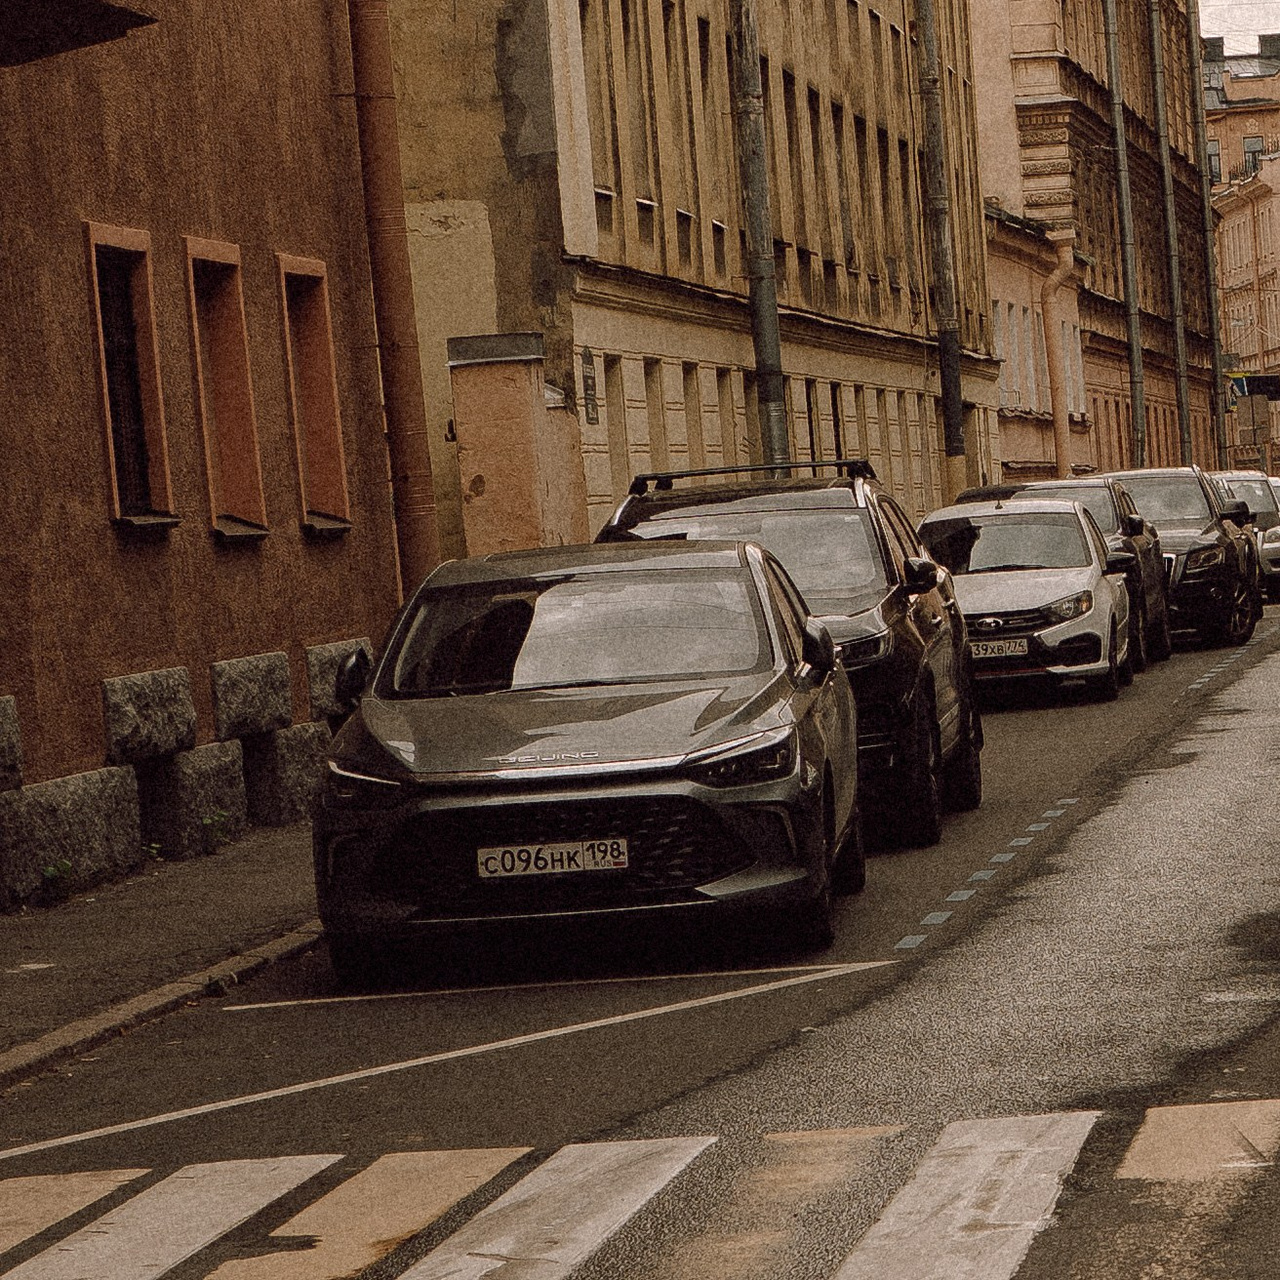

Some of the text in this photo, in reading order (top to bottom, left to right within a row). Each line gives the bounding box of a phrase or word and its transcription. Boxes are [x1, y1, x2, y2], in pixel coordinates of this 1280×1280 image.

[973, 643, 1004, 656] 39ХВ
[484, 841, 622, 874] С096НК 198
[594, 860, 612, 868] RUS
